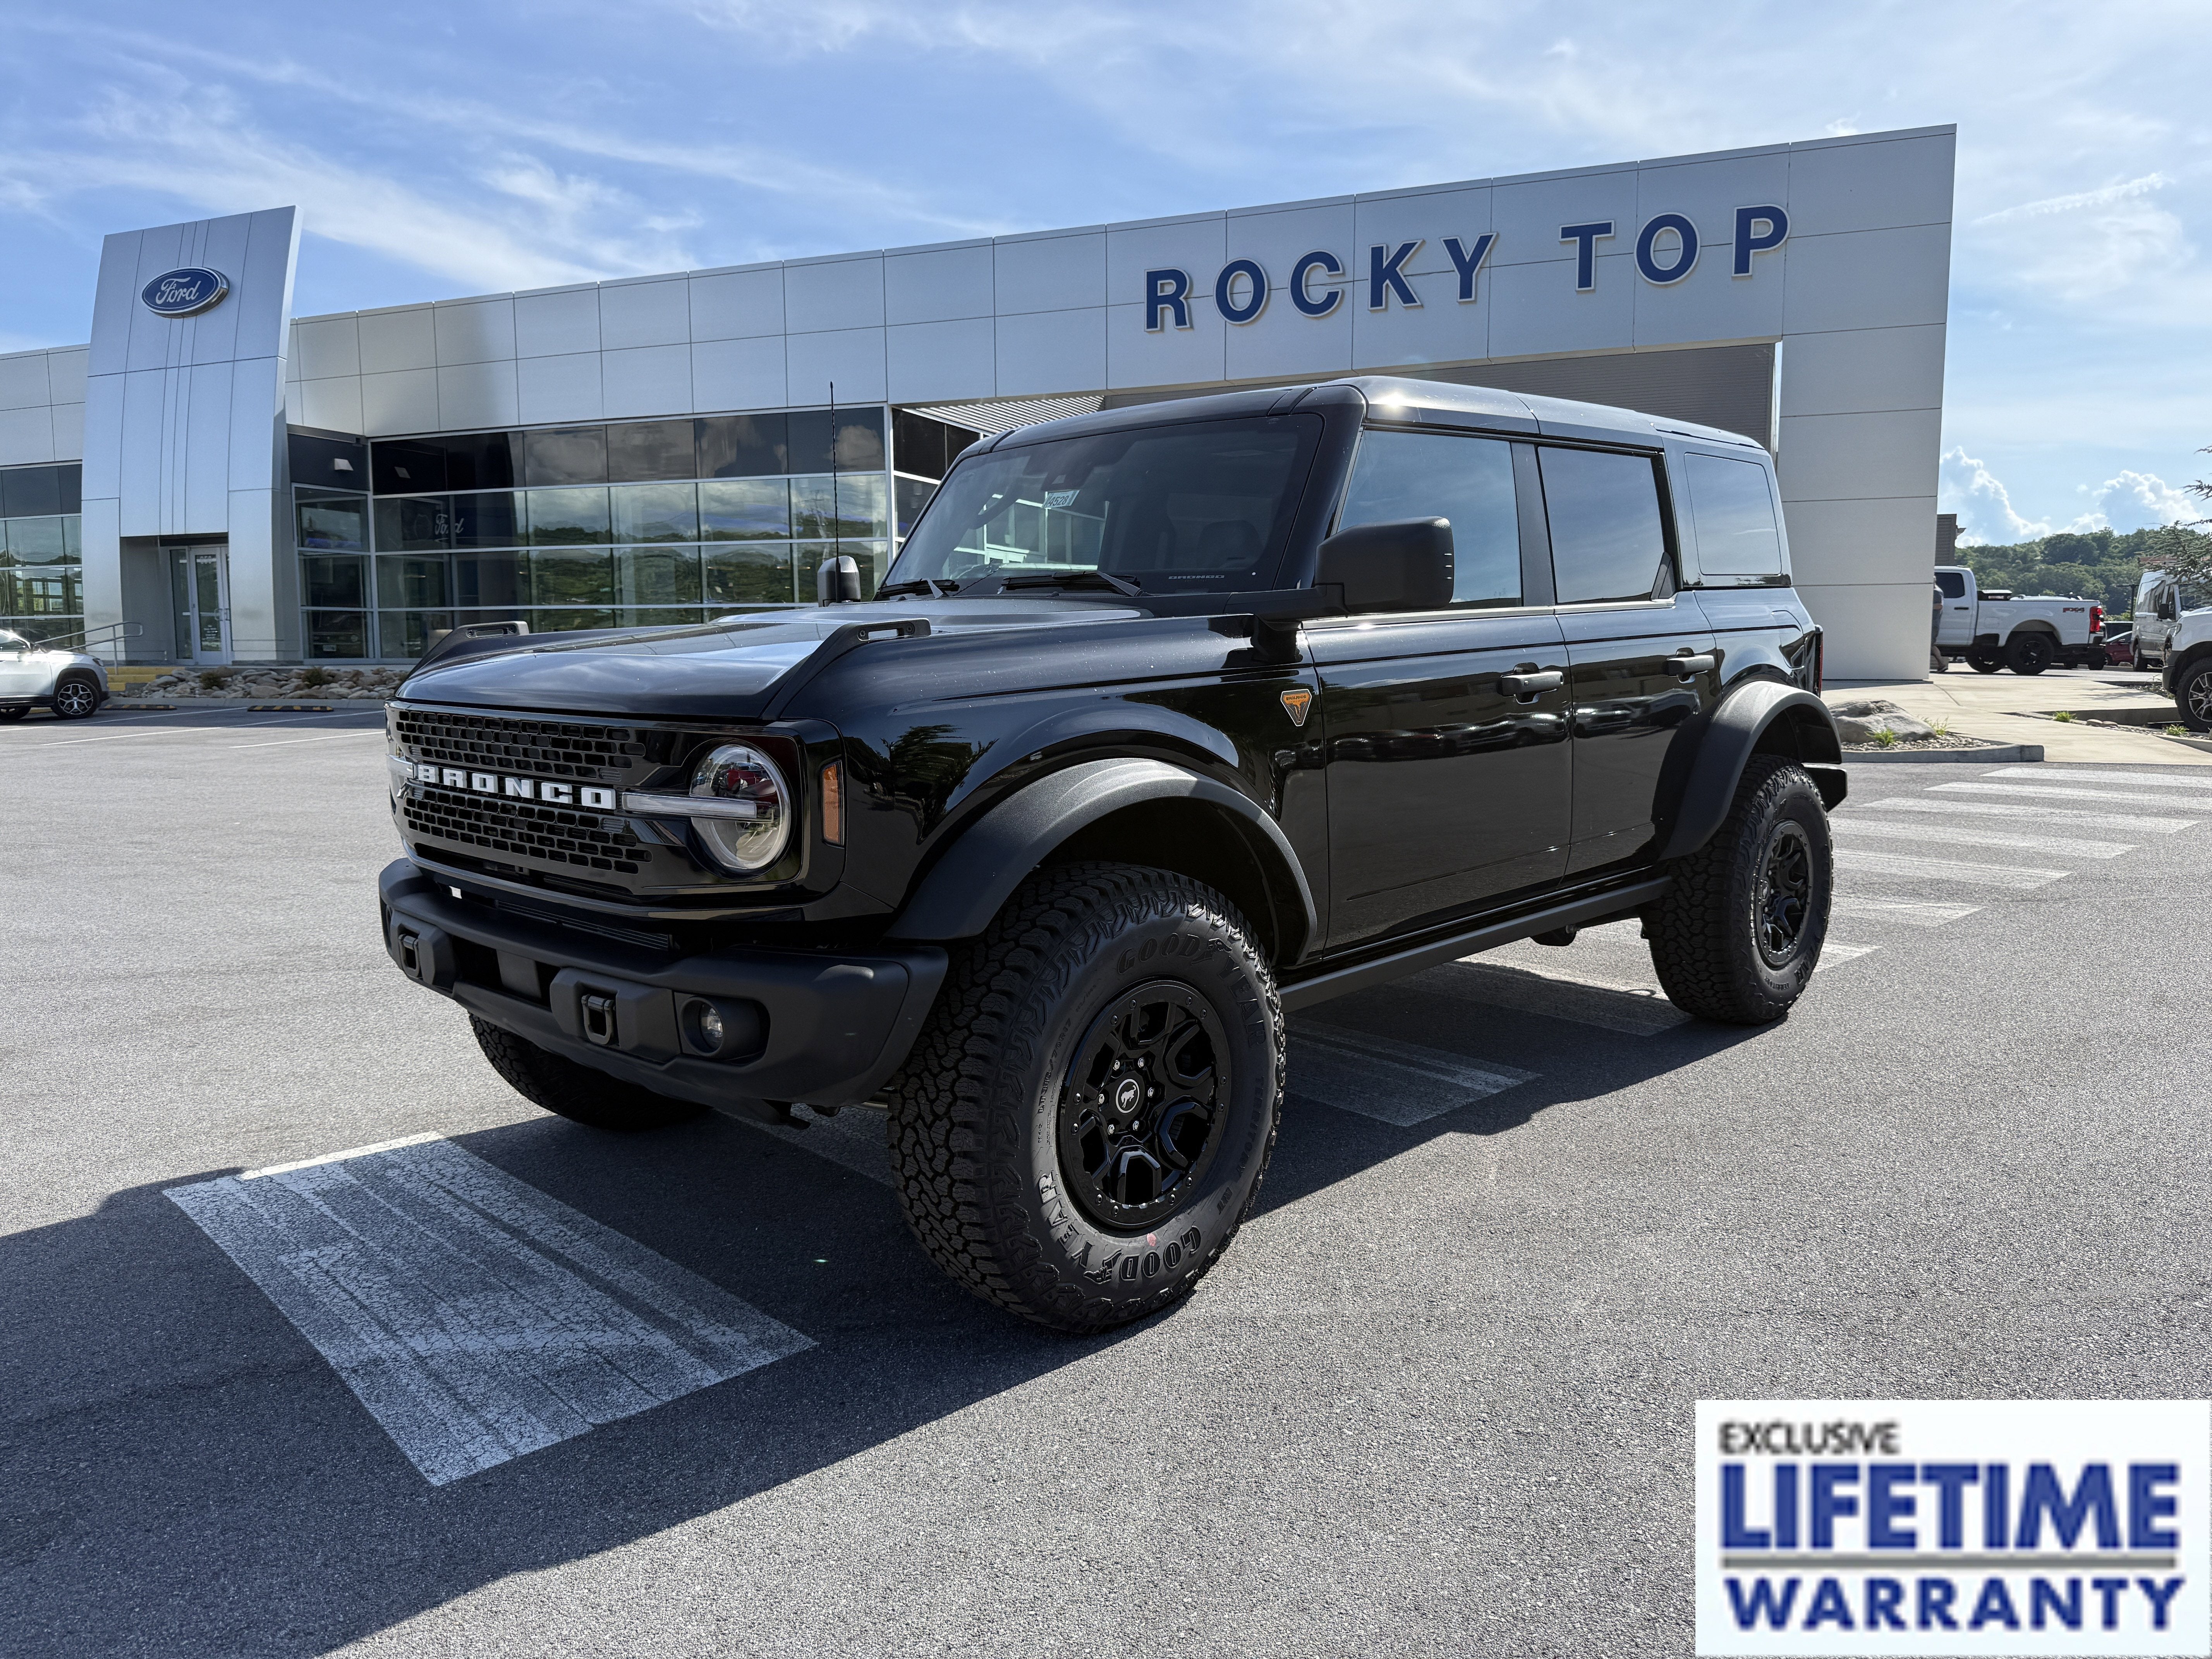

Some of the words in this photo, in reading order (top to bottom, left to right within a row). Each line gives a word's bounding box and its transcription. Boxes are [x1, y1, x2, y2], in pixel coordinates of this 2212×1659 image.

[156, 277, 201, 304] Ford
[1144, 231, 1499, 332] ROCKY
[1559, 204, 1791, 292] TOP
[1048, 496, 1069, 506] 4528
[418, 764, 616, 810] BRONCO
[1118, 933, 1267, 1048] GOODYEAR
[1237, 1075, 1264, 1178] TERRITORY
[1038, 1170, 1202, 1285] GOODYEAR
